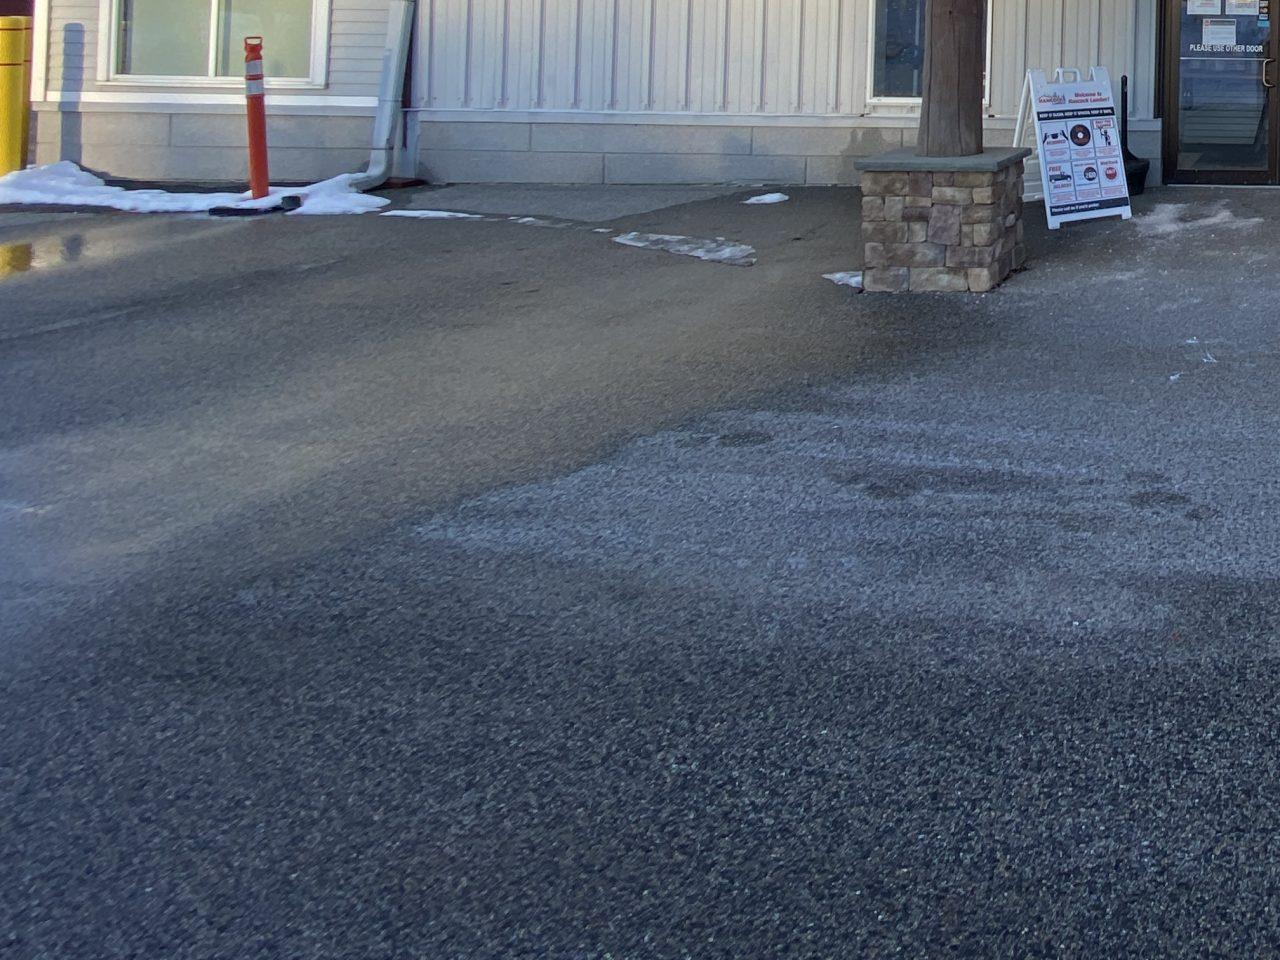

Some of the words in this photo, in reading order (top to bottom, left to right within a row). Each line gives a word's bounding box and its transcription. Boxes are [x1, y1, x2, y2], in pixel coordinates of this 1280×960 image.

[1190, 44, 1212, 52] PLEASE
[1213, 44, 1225, 52] USE
[1225, 44, 1245, 52] OTHER
